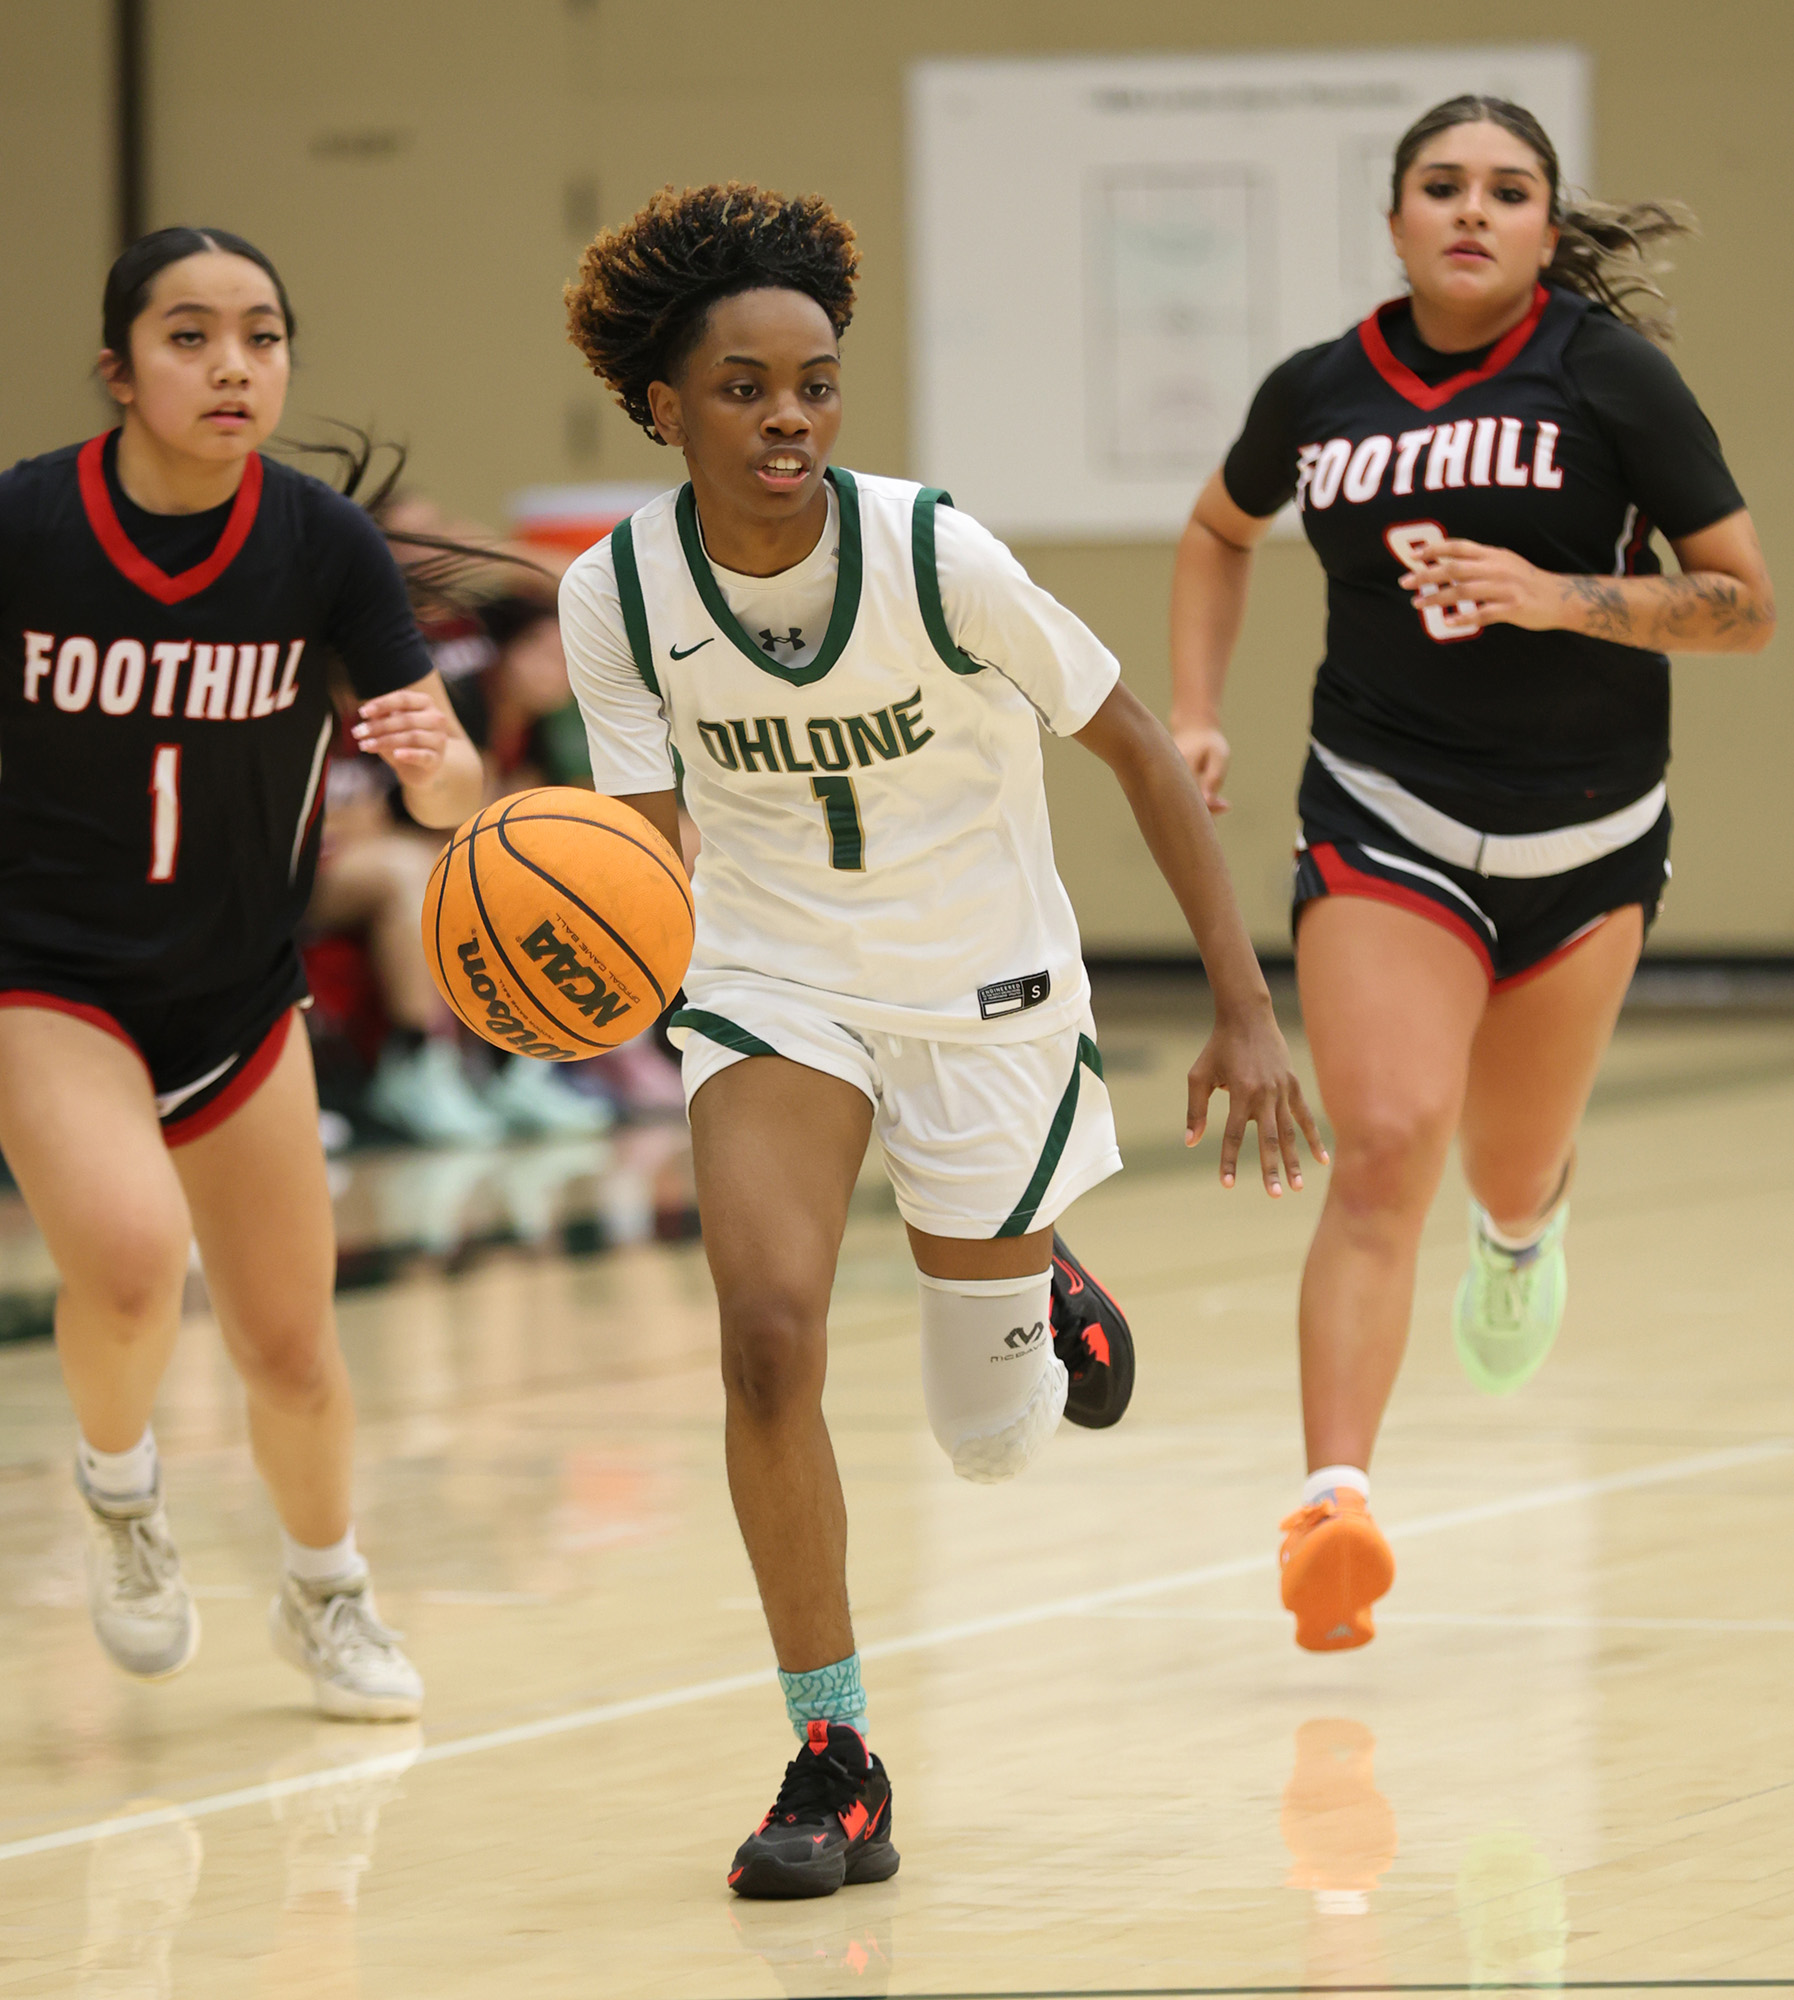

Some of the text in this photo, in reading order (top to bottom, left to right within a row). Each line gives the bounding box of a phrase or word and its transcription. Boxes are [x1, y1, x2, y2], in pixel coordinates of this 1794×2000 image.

[1297, 416, 1563, 511] FOOTHILL
[23, 630, 305, 720] FOOTHILL
[697, 685, 935, 772] OHLONE
[147, 743, 182, 883] 1
[809, 776, 866, 872] 1
[520, 919, 632, 1028] NCAA
[556, 912, 580, 943] BALL
[457, 937, 577, 1060] Wilson
[609, 971, 640, 1004] OFFICIAL
[1031, 985, 1041, 999] S
